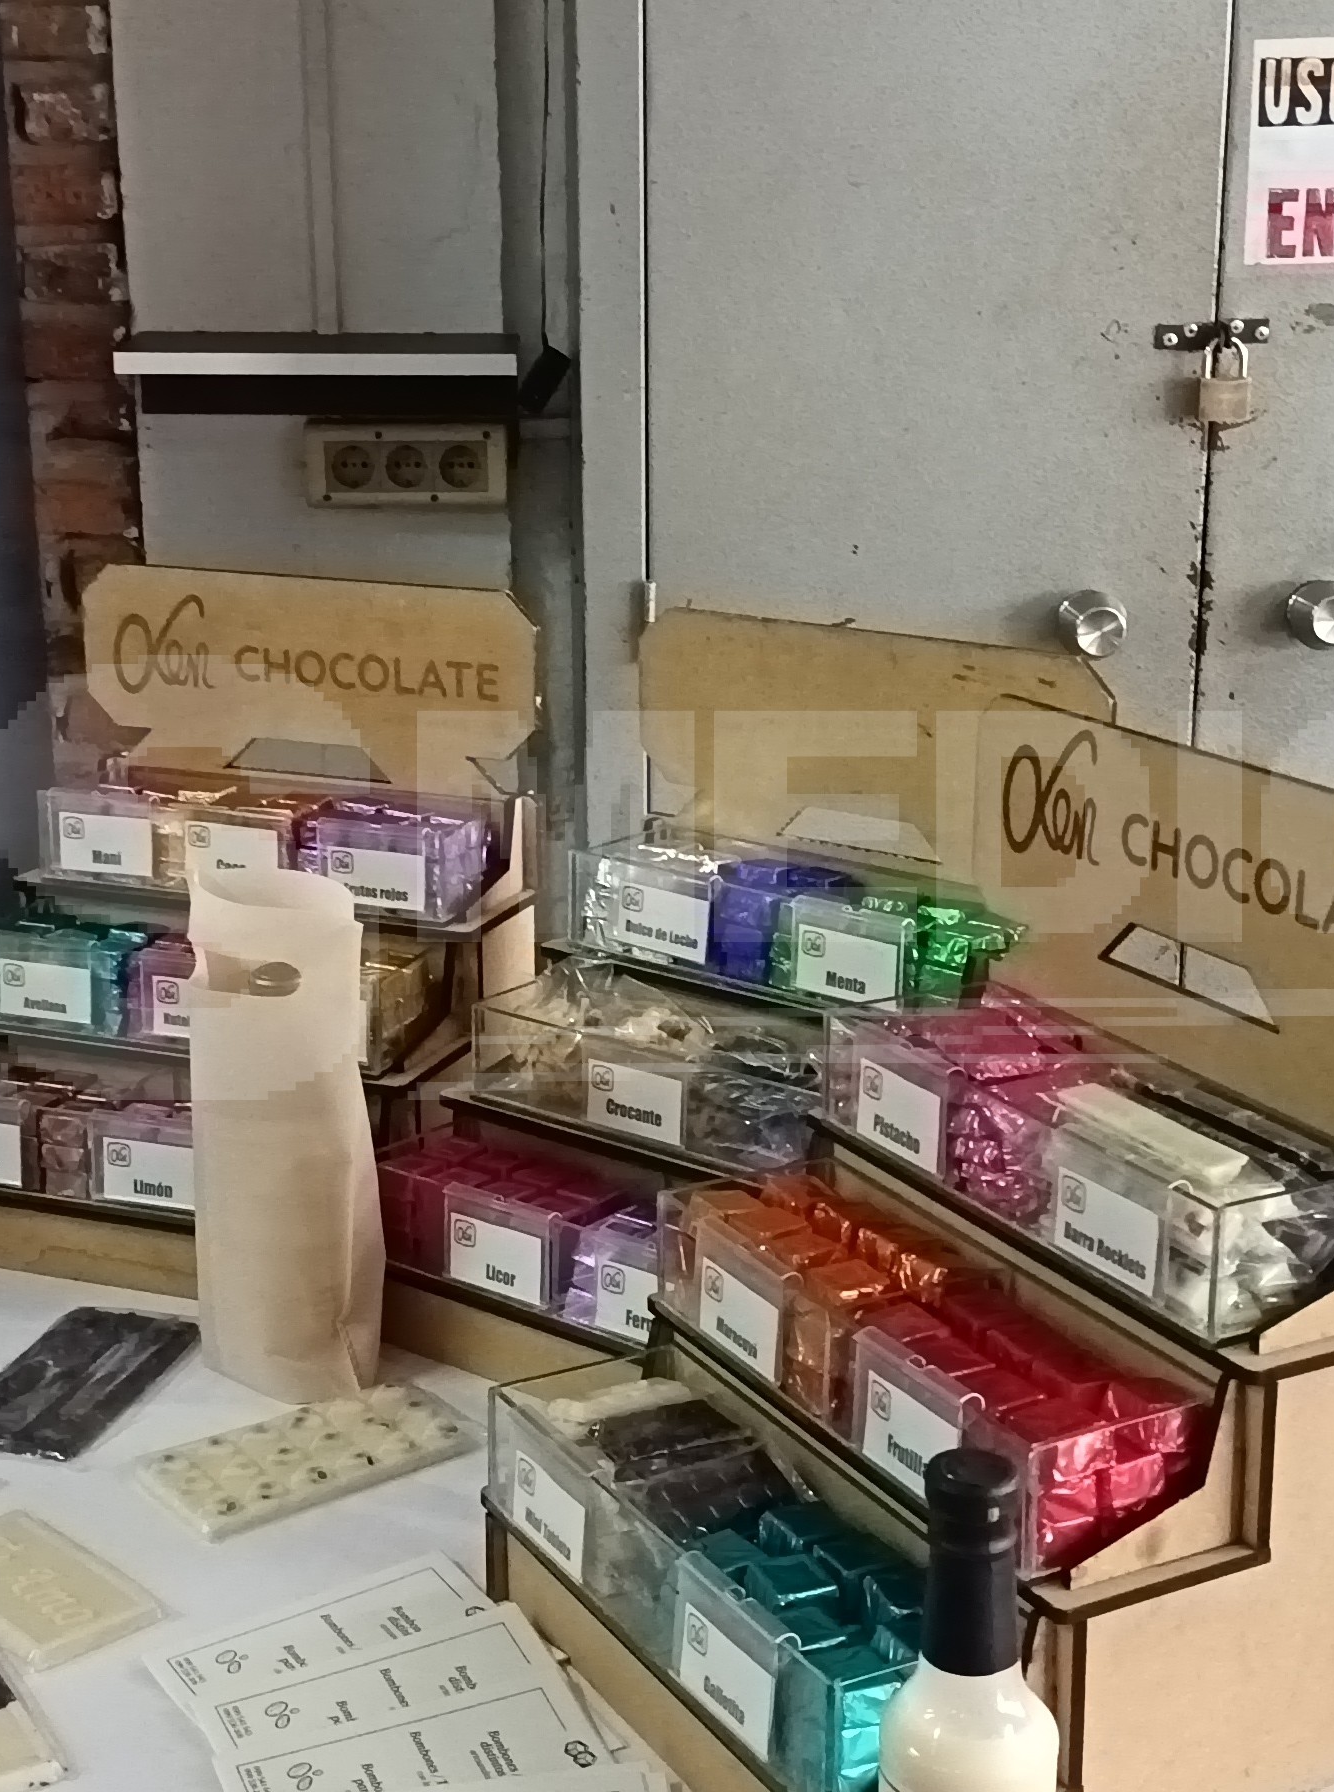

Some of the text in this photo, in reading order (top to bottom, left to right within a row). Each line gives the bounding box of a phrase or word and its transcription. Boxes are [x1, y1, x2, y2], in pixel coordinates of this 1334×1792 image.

[234, 644, 499, 702] CHOCOLATE
[825, 970, 867, 995] Menta
[605, 1097, 663, 1128] Crocante
[873, 1112, 921, 1155] Pistacho
[133, 1178, 174, 1199] Limón
[485, 1262, 517, 1288] Licor
[887, 1432, 926, 1478] Frutill
